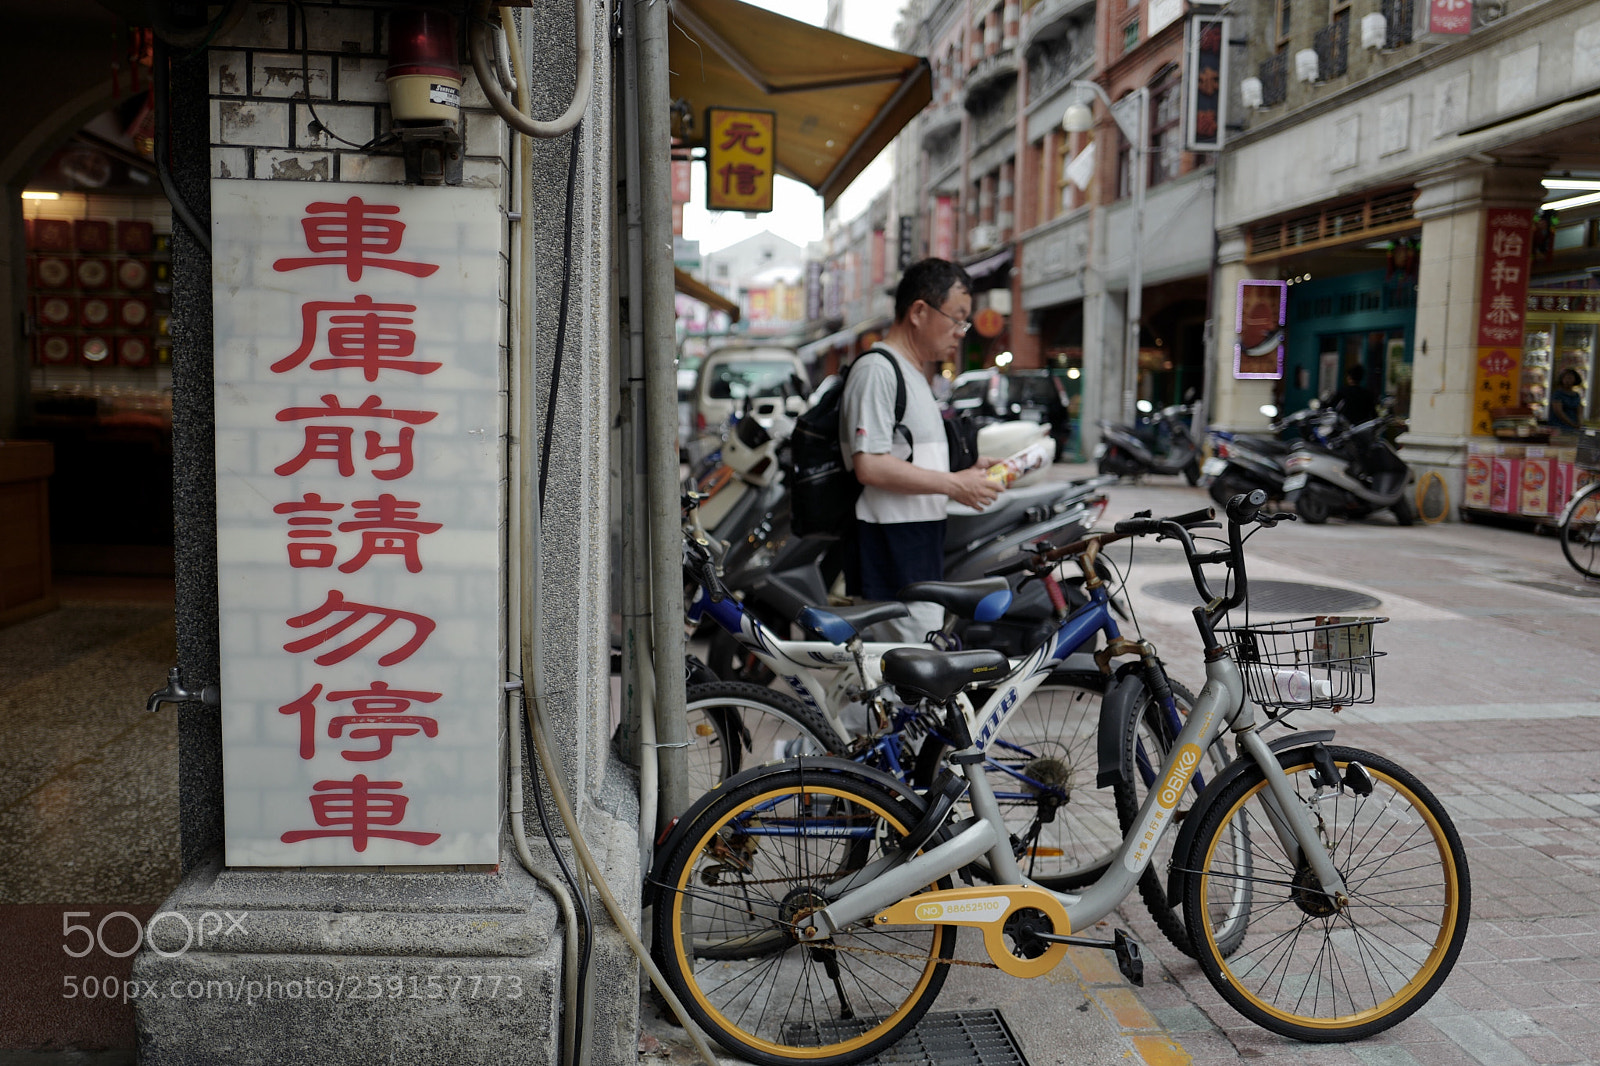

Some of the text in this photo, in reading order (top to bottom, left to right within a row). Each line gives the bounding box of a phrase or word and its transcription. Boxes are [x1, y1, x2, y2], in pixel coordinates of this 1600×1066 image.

[719, 122, 765, 196] 元信
[270, 195, 443, 854] 車庫前請勿停車
[973, 687, 1019, 752] MTB
[1132, 809, 1165, 863] 共享自行車
[946, 901, 1000, 914] 886525100
